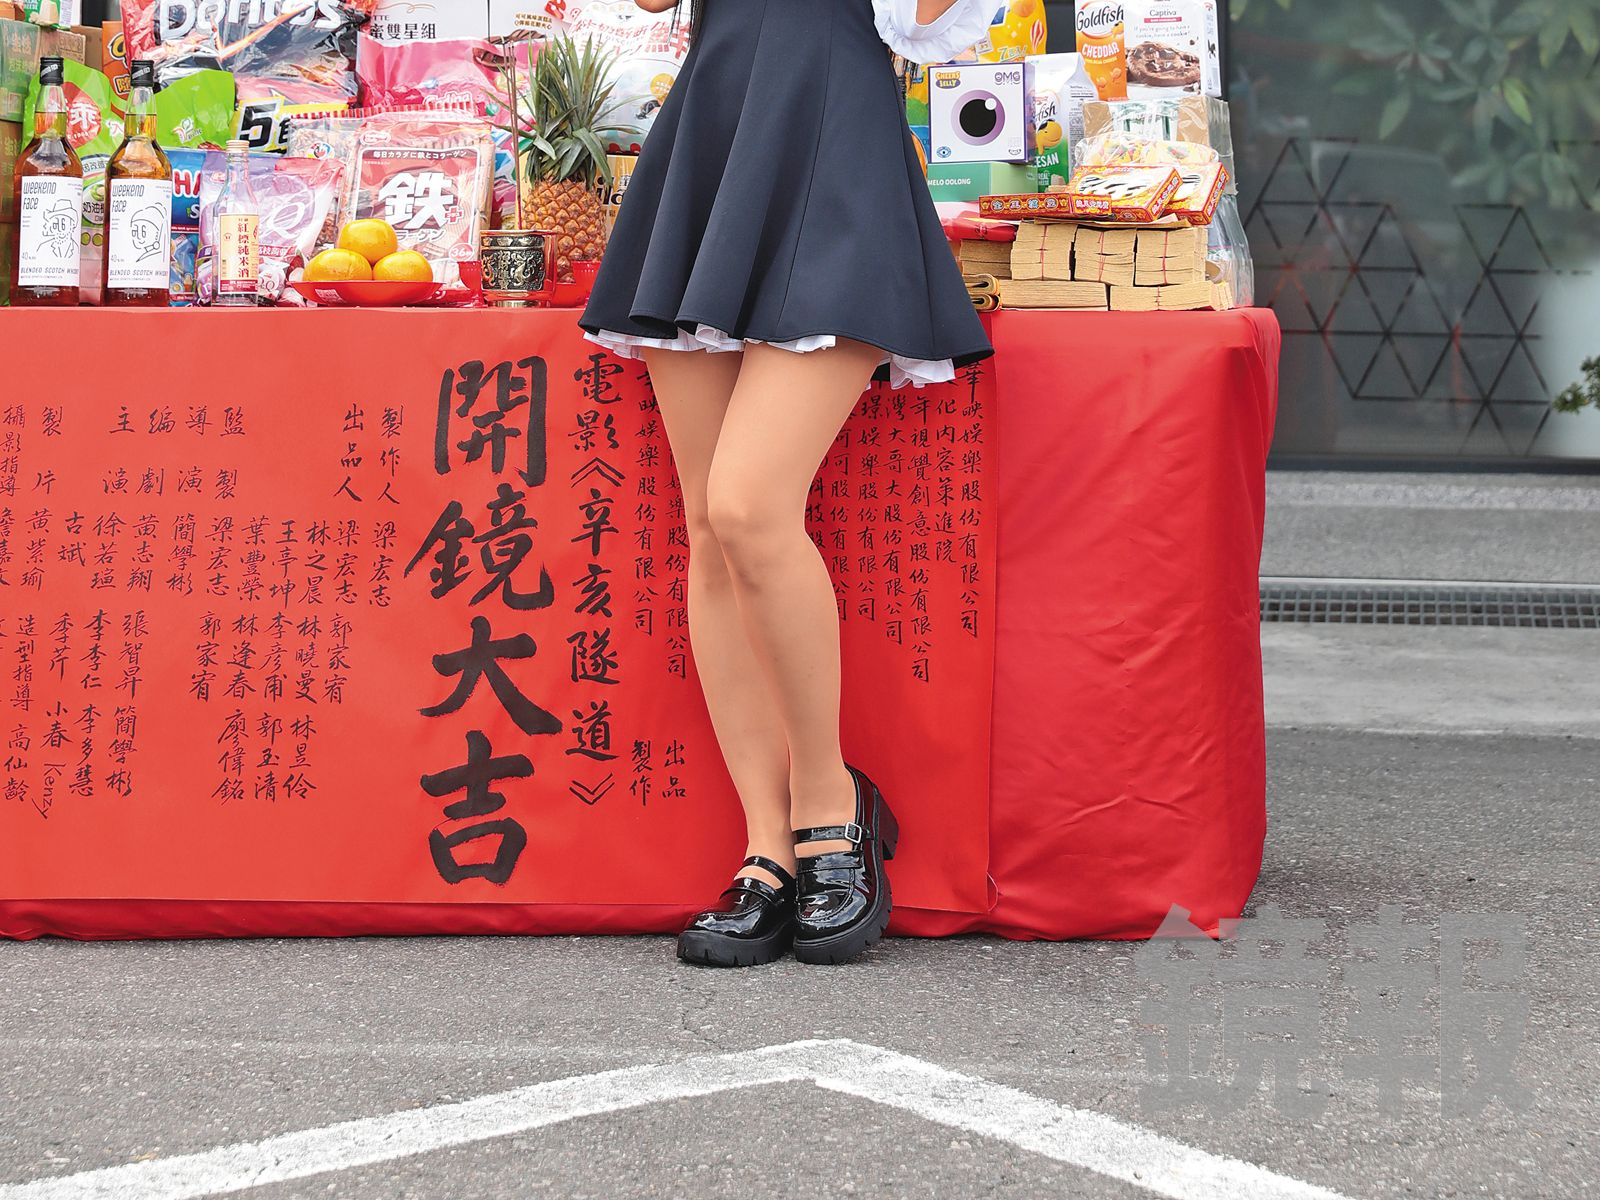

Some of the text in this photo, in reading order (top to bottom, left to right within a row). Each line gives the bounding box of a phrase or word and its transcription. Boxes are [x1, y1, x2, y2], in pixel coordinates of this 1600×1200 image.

[1076, 5, 1124, 31] Goldfish
[1082, 42, 1119, 59] CHEDDAR
[1150, 9, 1177, 17] Captiva
[1036, 101, 1056, 120] fish
[378, 172, 455, 230] 鉄
[1035, 153, 1059, 168] ESAN
[238, 223, 249, 278] 紅標純米酒
[396, 230, 444, 242] ラーゲン
[334, 403, 363, 501] 出品人
[933, 378, 957, 563] 化內容策進院
[58, 512, 86, 566] 古斌
[369, 405, 403, 607] 製作人 梁宏志
[857, 380, 882, 622] 璟娛樂股份有限公司
[882, 394, 906, 645] 灣大哥大股份有限公司
[907, 384, 932, 683] 年視覺創意股份有限公司
[91, 512, 126, 589] 徐若瑄
[166, 513, 196, 594] 簡學彬
[205, 517, 234, 595] 梁宏志
[268, 520, 300, 608] 王亭坤
[297, 521, 331, 604] 林之晨
[334, 520, 360, 604] 梁宏志
[49, 613, 73, 680] 季芹
[80, 609, 111, 689] 李李仁
[115, 610, 148, 699] 張智昇
[223, 614, 261, 699] 林逢春
[296, 616, 321, 703] 林曉曼
[403, 355, 563, 886] 開鏡大吉
[43, 701, 75, 748] 小春
[68, 704, 101, 796] 李多慧
[106, 706, 137, 797] 簡學彬
[212, 709, 248, 804] 廖偉銘
[255, 712, 284, 802] 郭玉清
[630, 740, 653, 806] 製作
[662, 740, 686, 798] 出品
